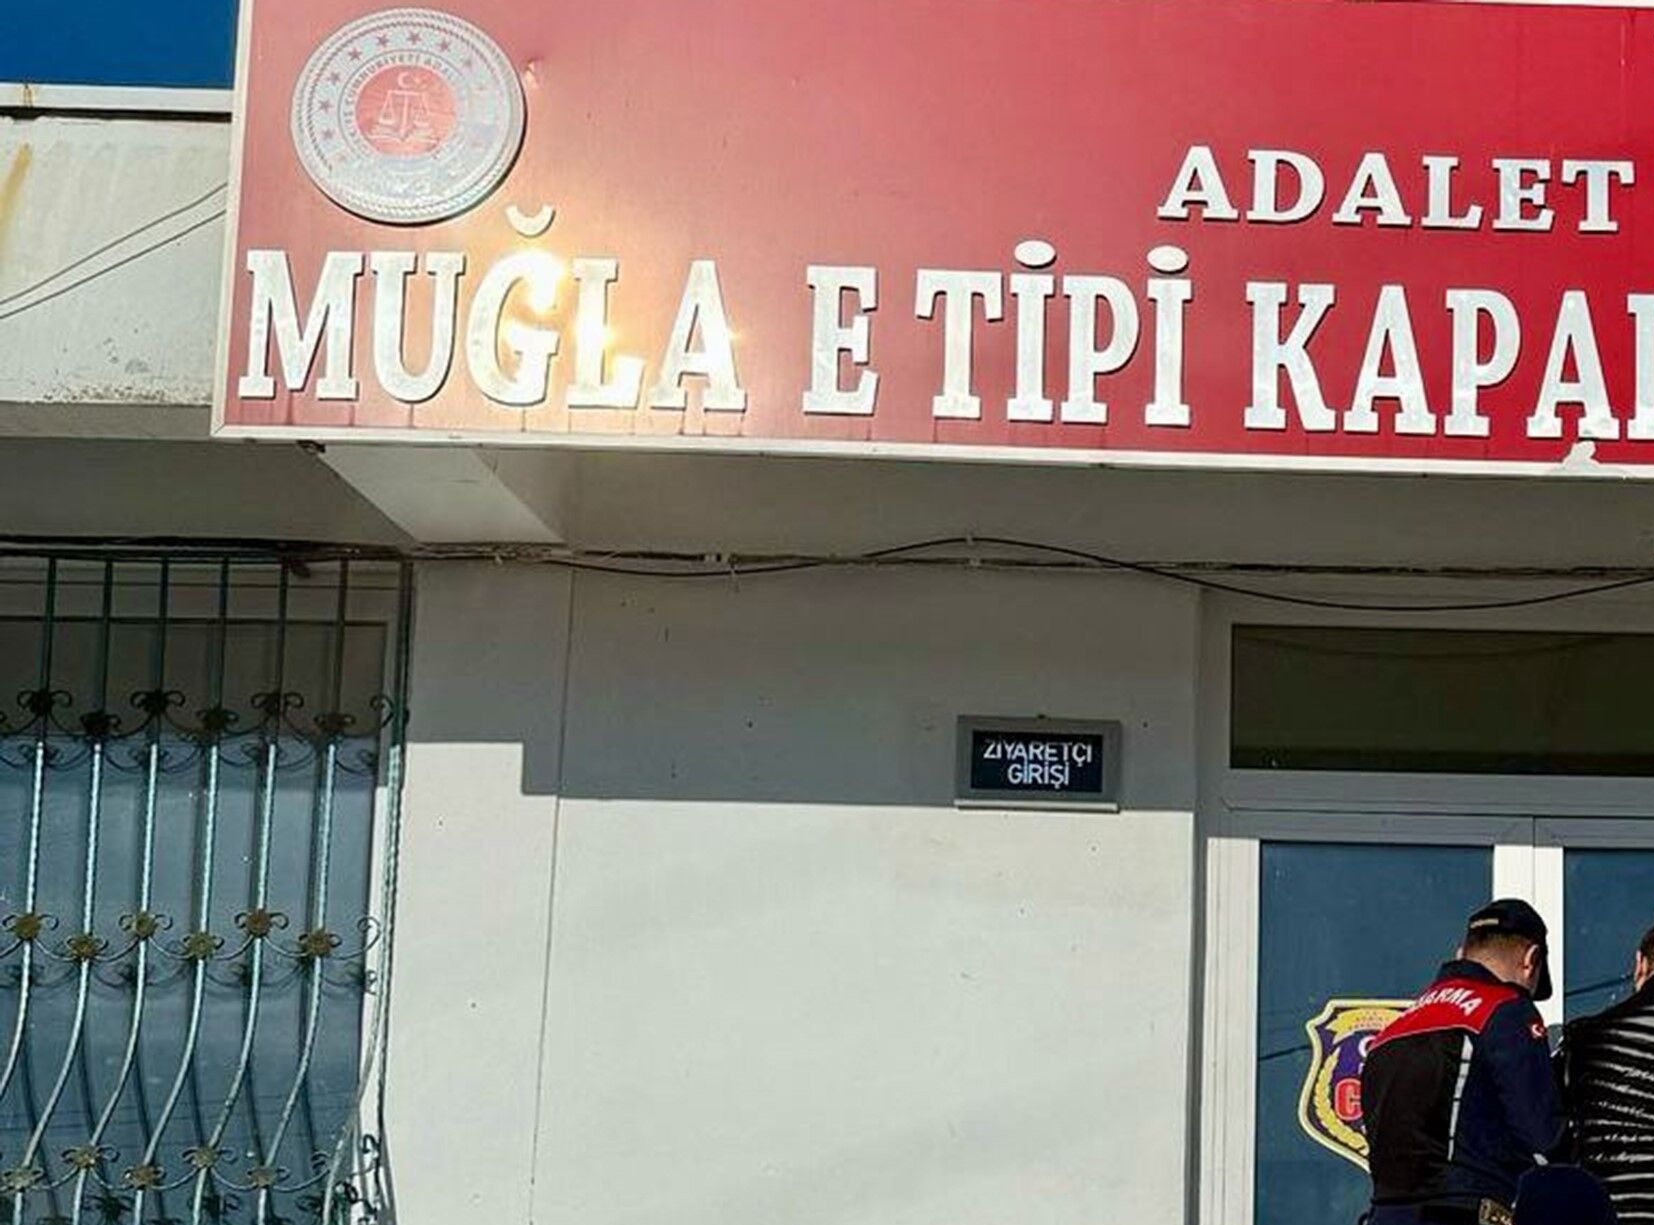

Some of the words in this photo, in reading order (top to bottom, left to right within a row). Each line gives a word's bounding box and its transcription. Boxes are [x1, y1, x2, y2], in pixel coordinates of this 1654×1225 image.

[1156, 144, 1637, 235] ADALET
[237, 204, 748, 412] MUĞLA
[801, 264, 880, 416] E
[914, 240, 1194, 428] TİPİ
